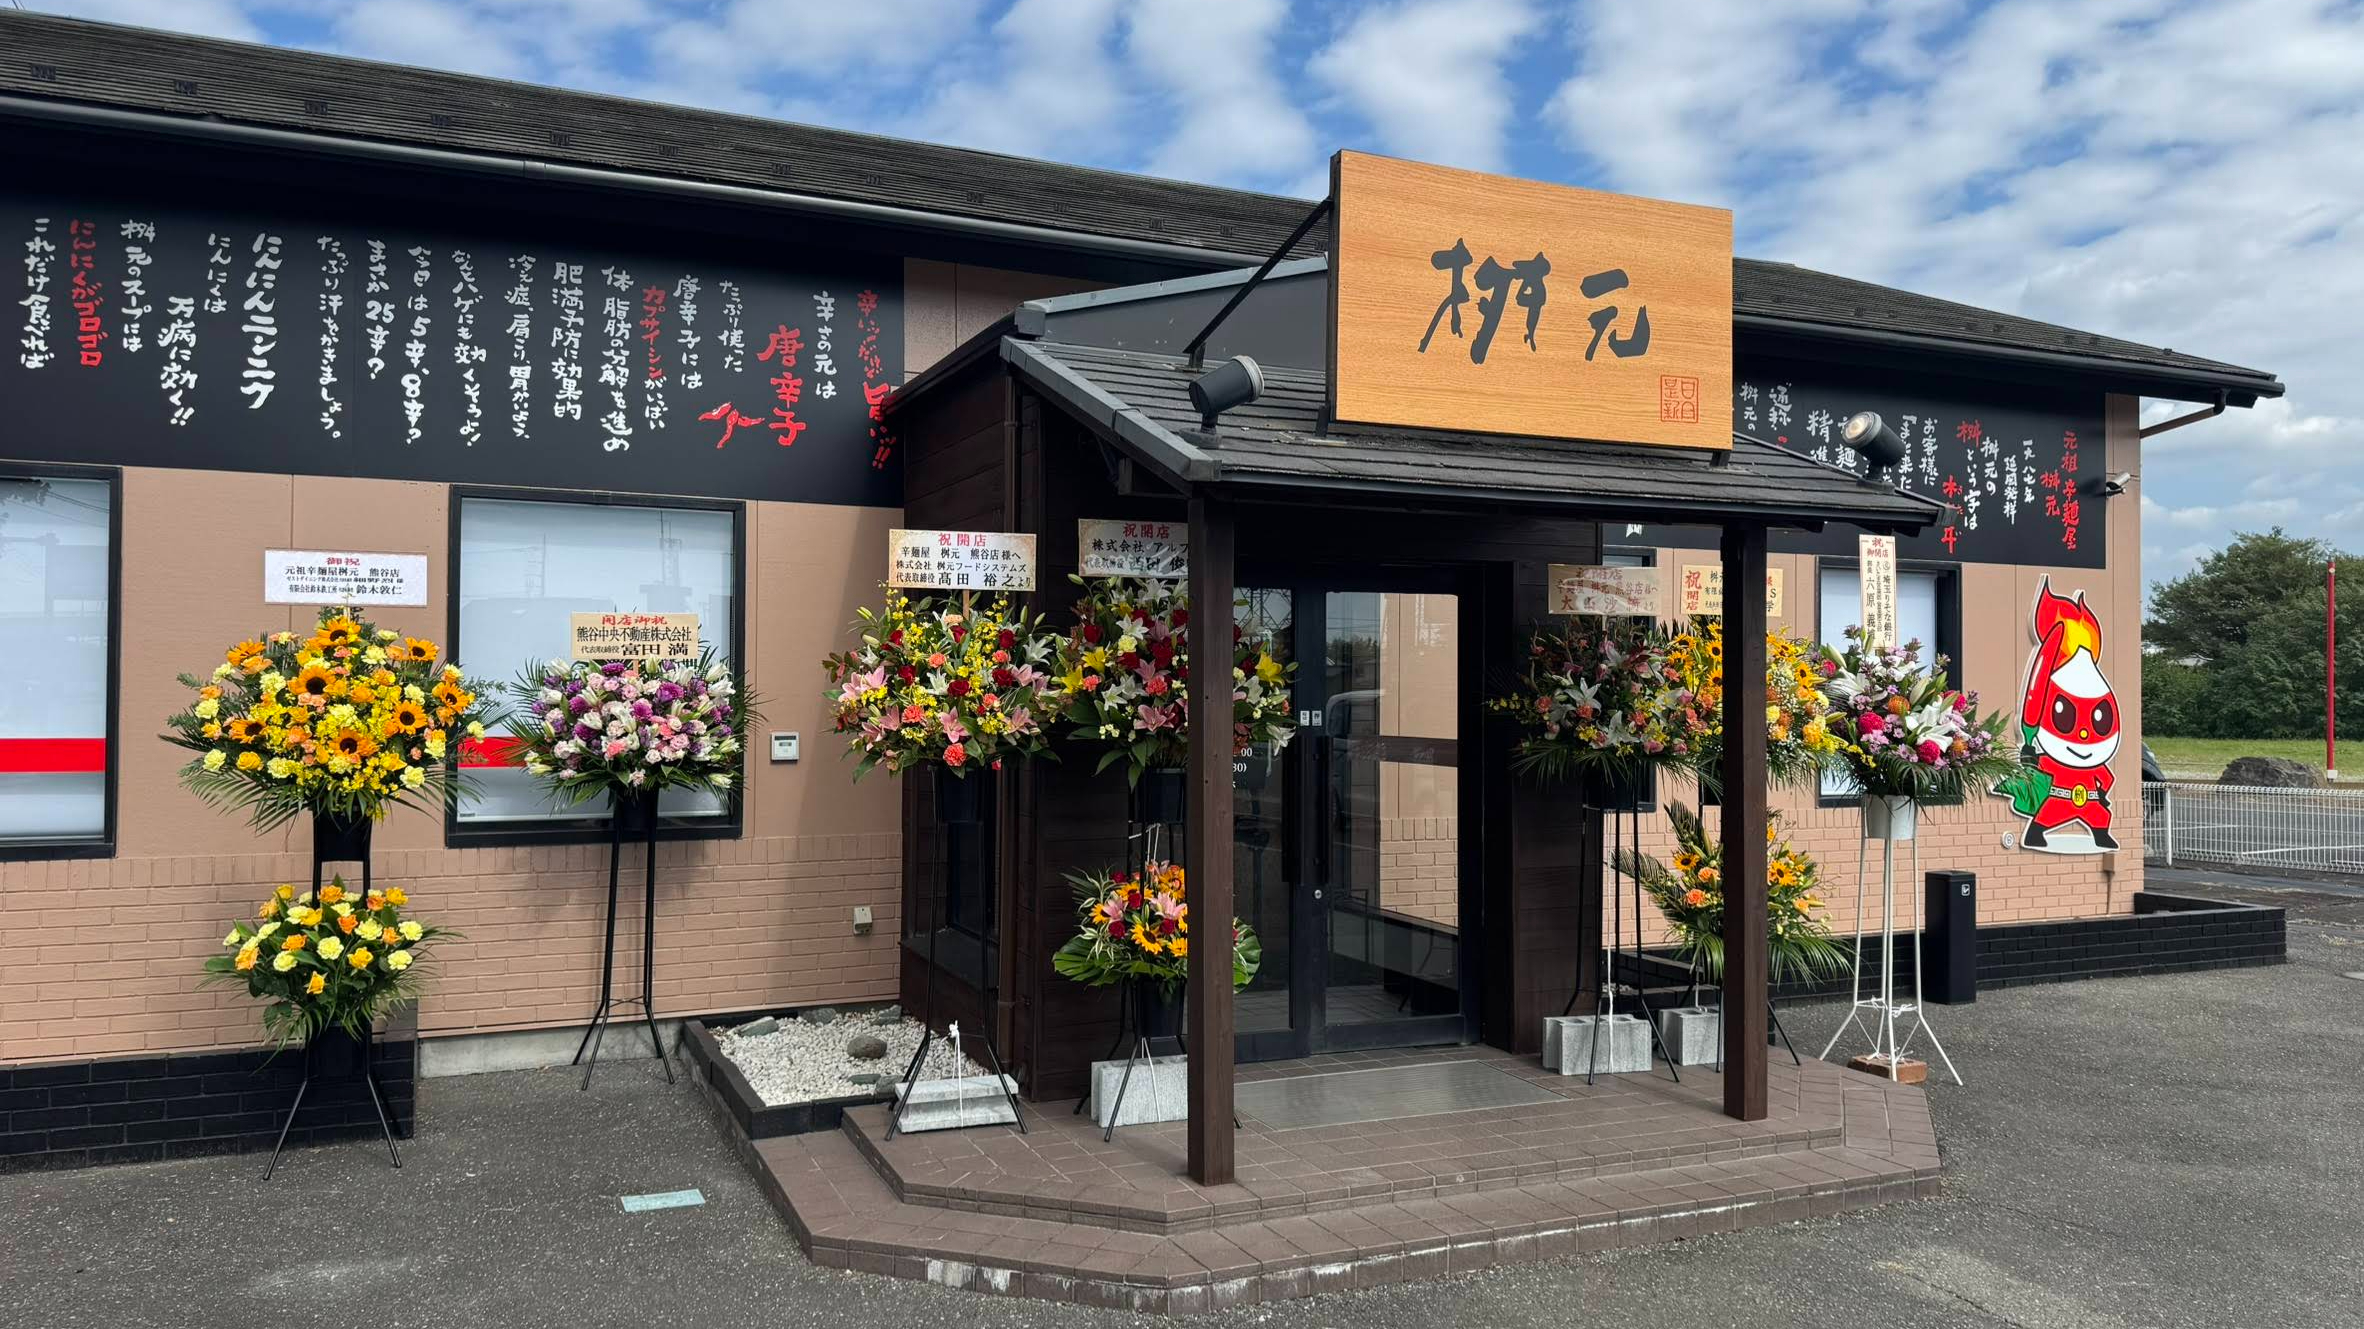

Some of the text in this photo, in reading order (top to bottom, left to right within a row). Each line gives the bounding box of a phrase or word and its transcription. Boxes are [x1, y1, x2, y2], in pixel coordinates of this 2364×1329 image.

[19, 219, 55, 369] これだけ食べれば
[70, 219, 108, 366] にんにくがゴロゴロ
[121, 220, 155, 352] 桝元のスープには
[204, 234, 231, 313] にんにくは
[240, 234, 282, 409] にんにんニンニク
[1418, 237, 1650, 364] 桝元
[317, 235, 348, 439] たっぷり汗をかきましょう。
[551, 262, 584, 421] 肥満予防に効果的
[600, 265, 635, 452] 体脂肪の分解を進め
[639, 284, 669, 430] カプサイシンがいっぱい
[673, 273, 703, 390] 唐辛子には
[718, 279, 746, 374] たっぷり使った
[812, 289, 837, 400] 辛さの元は
[757, 324, 807, 447] 唐辛子
[1918, 417, 1939, 487] お客様に
[2003, 454, 2020, 525] 延岡発祥
[2022, 439, 2037, 504] 一九八七年
[369, 568, 400, 577] 熊谷店
[896, 560, 1027, 572] 株式会社 桝元フードシステムズ
[896, 572, 935, 583] 代表取締役
[901, 546, 930, 558] 辛麺屋
[941, 547, 960, 559] 桝元
[938, 533, 987, 547] 祝開店
[1123, 523, 1170, 539] 祝開店
[577, 626, 692, 642] 熊谷中央不動産株式会社
